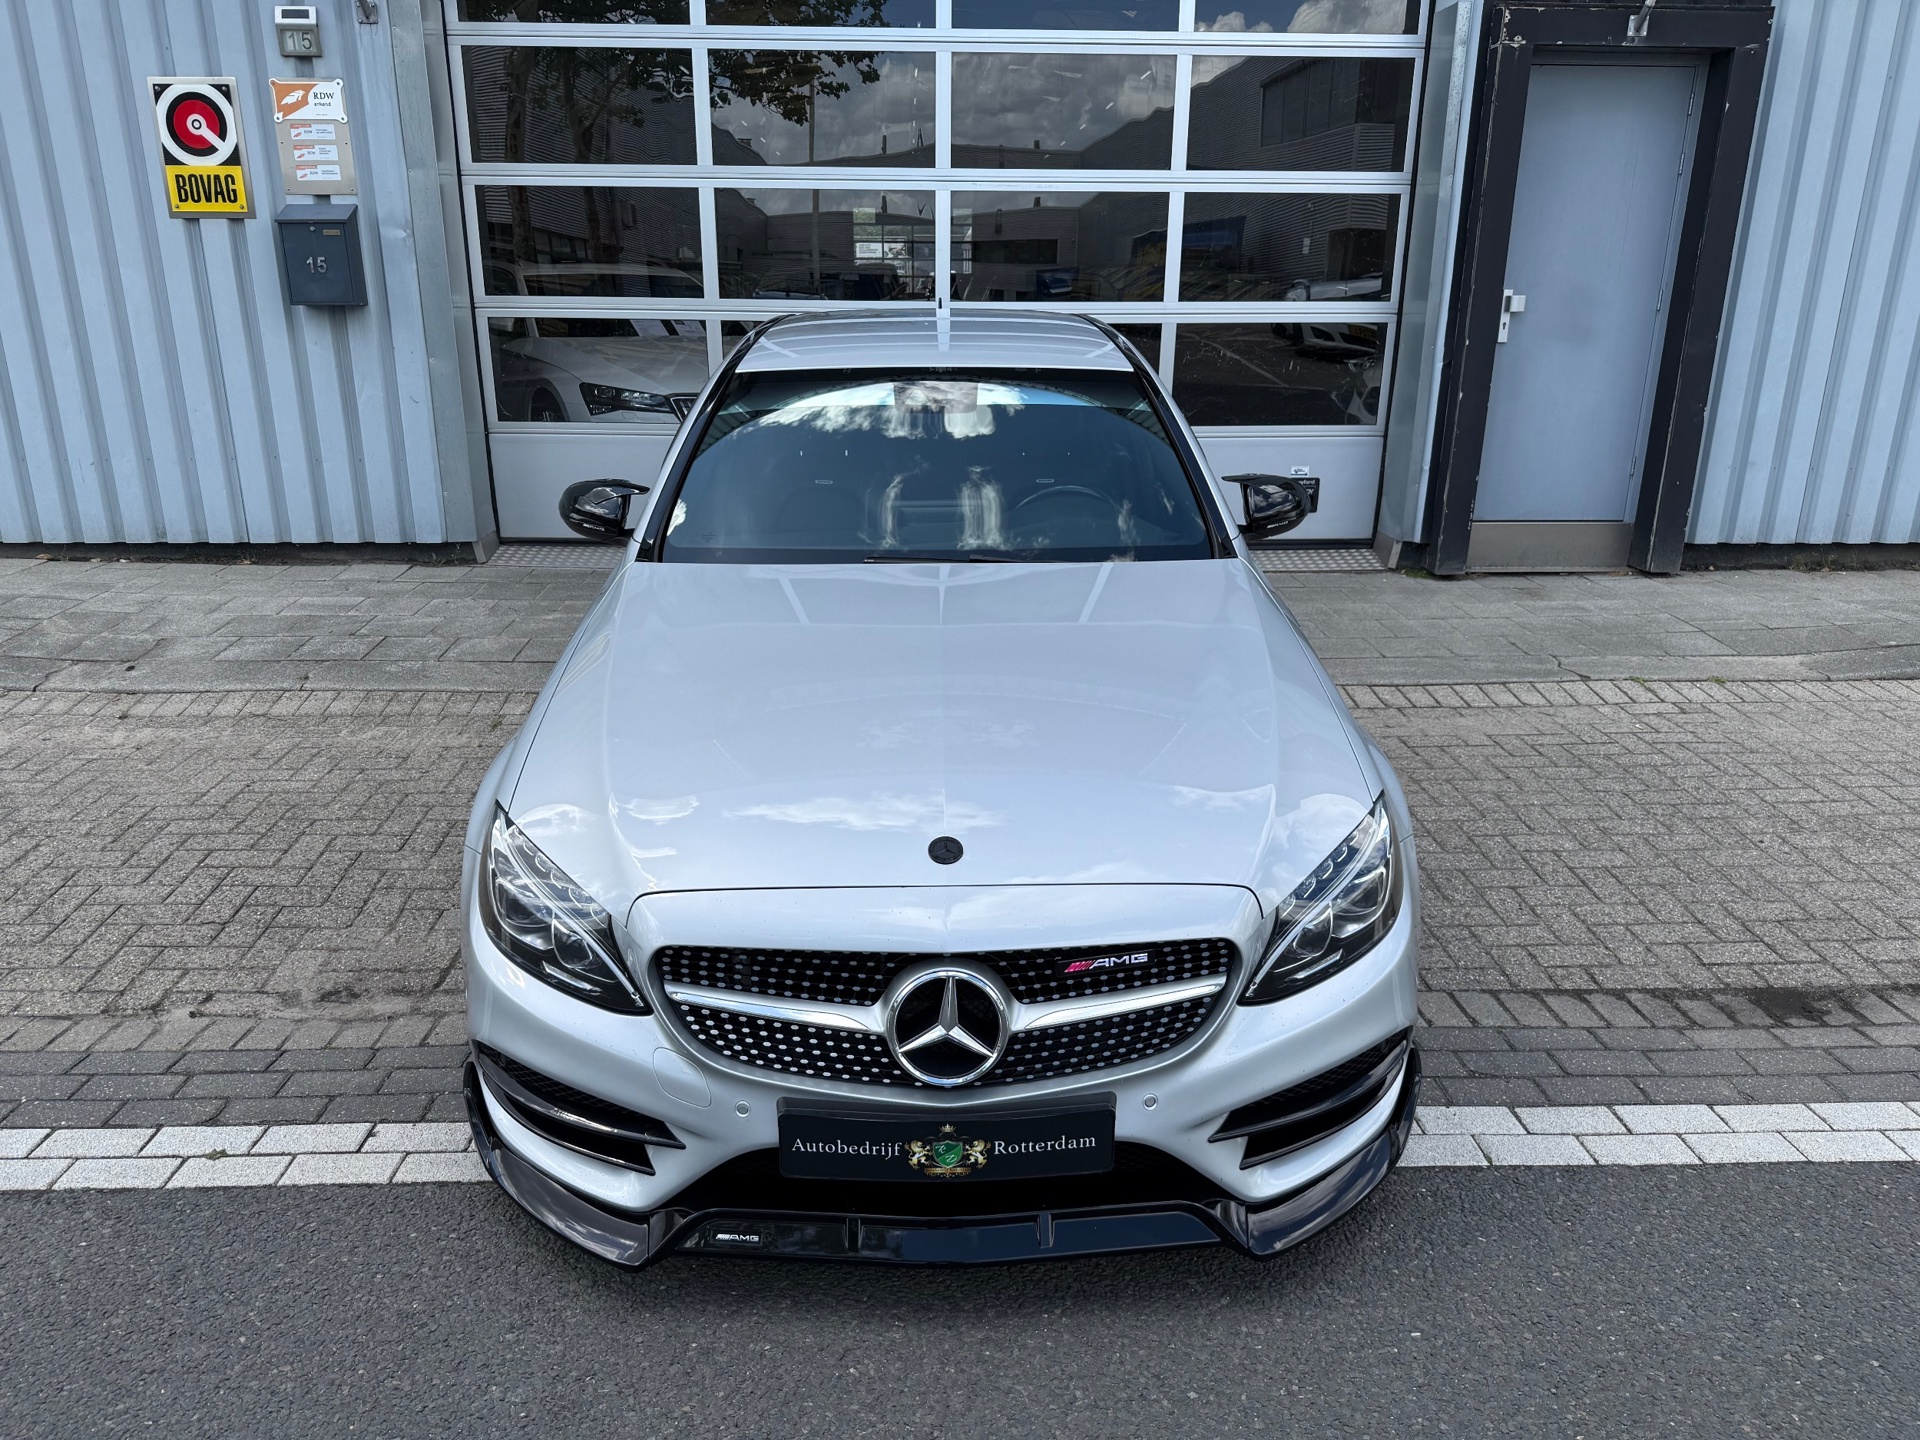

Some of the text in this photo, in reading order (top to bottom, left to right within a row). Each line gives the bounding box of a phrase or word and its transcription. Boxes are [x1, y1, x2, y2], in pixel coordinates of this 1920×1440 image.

[288, 31, 312, 50] 15
[313, 92, 334, 100] RDW
[174, 173, 238, 204] BOVAG
[306, 256, 327, 273] 15
[1089, 953, 1148, 969] AMG
[791, 1135, 1096, 1160] Autobedrijf Rotterdam
[729, 1234, 760, 1242] AMG
